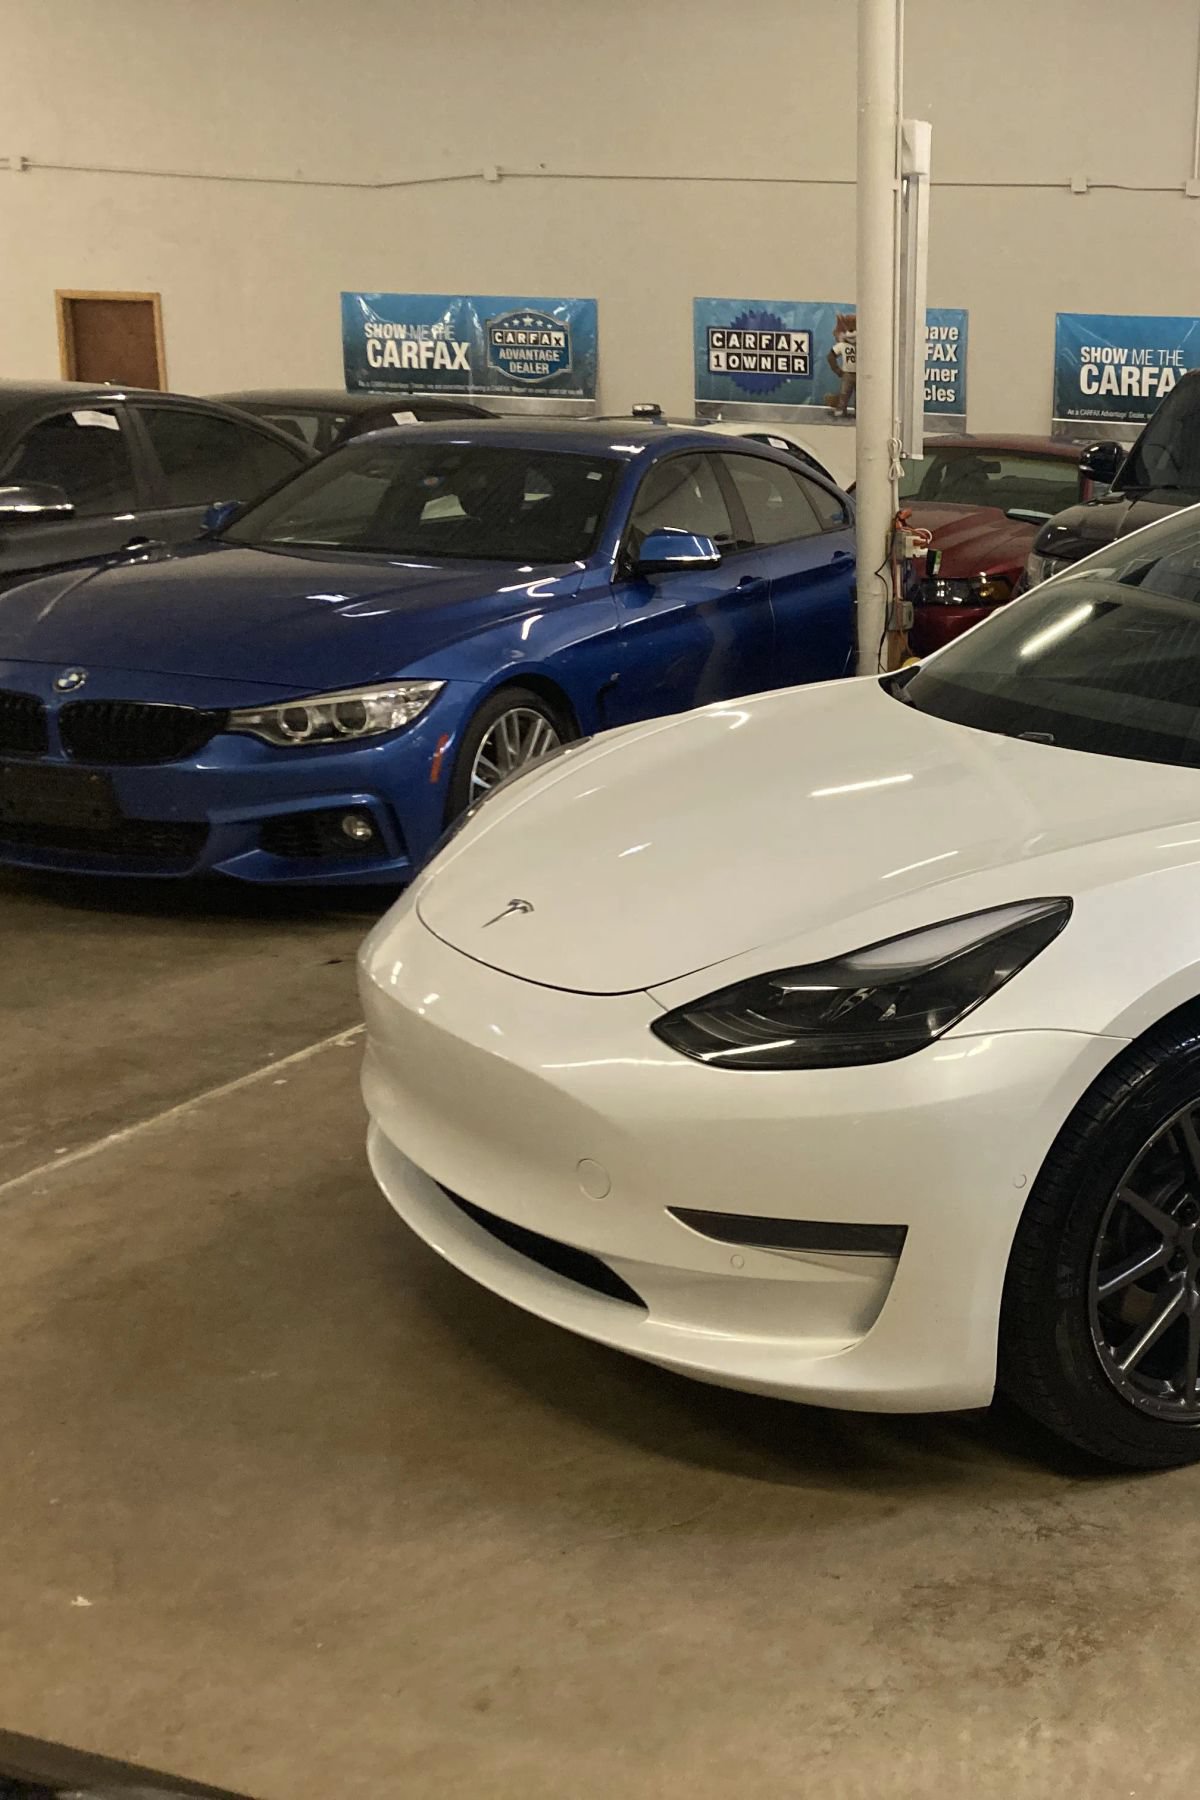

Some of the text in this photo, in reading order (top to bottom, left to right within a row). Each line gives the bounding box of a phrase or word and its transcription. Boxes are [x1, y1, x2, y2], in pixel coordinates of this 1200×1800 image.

[364, 322, 407, 339] SHOW
[409, 324, 429, 340] ME
[494, 332, 562, 346] CARFAX
[712, 332, 805, 352] CARFAX
[366, 338, 471, 370] CARFAX
[499, 348, 560, 361] ADVANTAGE
[845, 347, 857, 355] CA
[925, 344, 958, 362] FAX
[1080, 346, 1184, 366] SHOW ME THE
[509, 361, 550, 374] DEALER
[846, 356, 857, 364] FO
[1080, 364, 1187, 397] CARFA
[925, 385, 956, 401] cles
